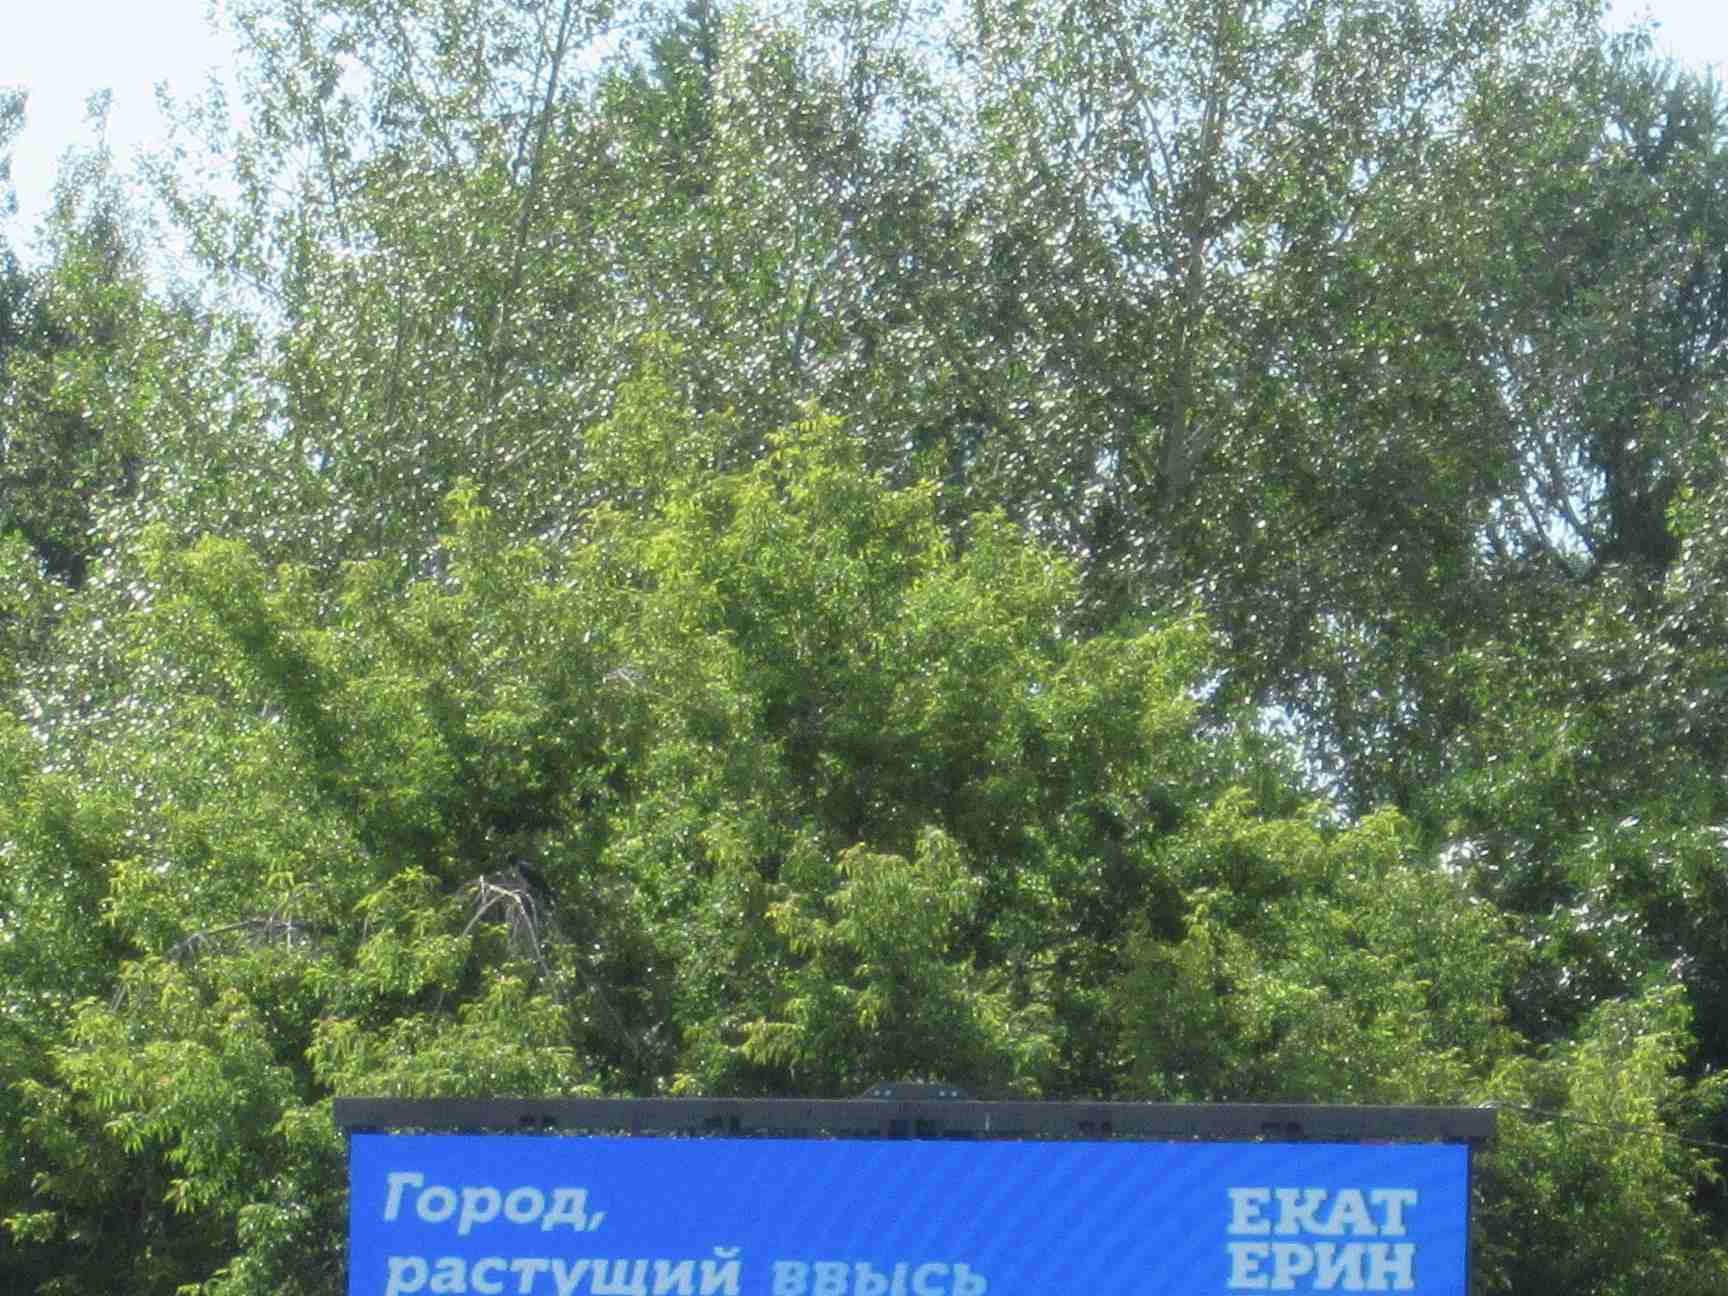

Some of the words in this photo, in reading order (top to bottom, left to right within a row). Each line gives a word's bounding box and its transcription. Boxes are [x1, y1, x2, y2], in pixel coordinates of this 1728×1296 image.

[383, 1171, 608, 1235] Город,
[1226, 1186, 1418, 1237] ЕКАТ
[1226, 1241, 1417, 1291] ЕРИН
